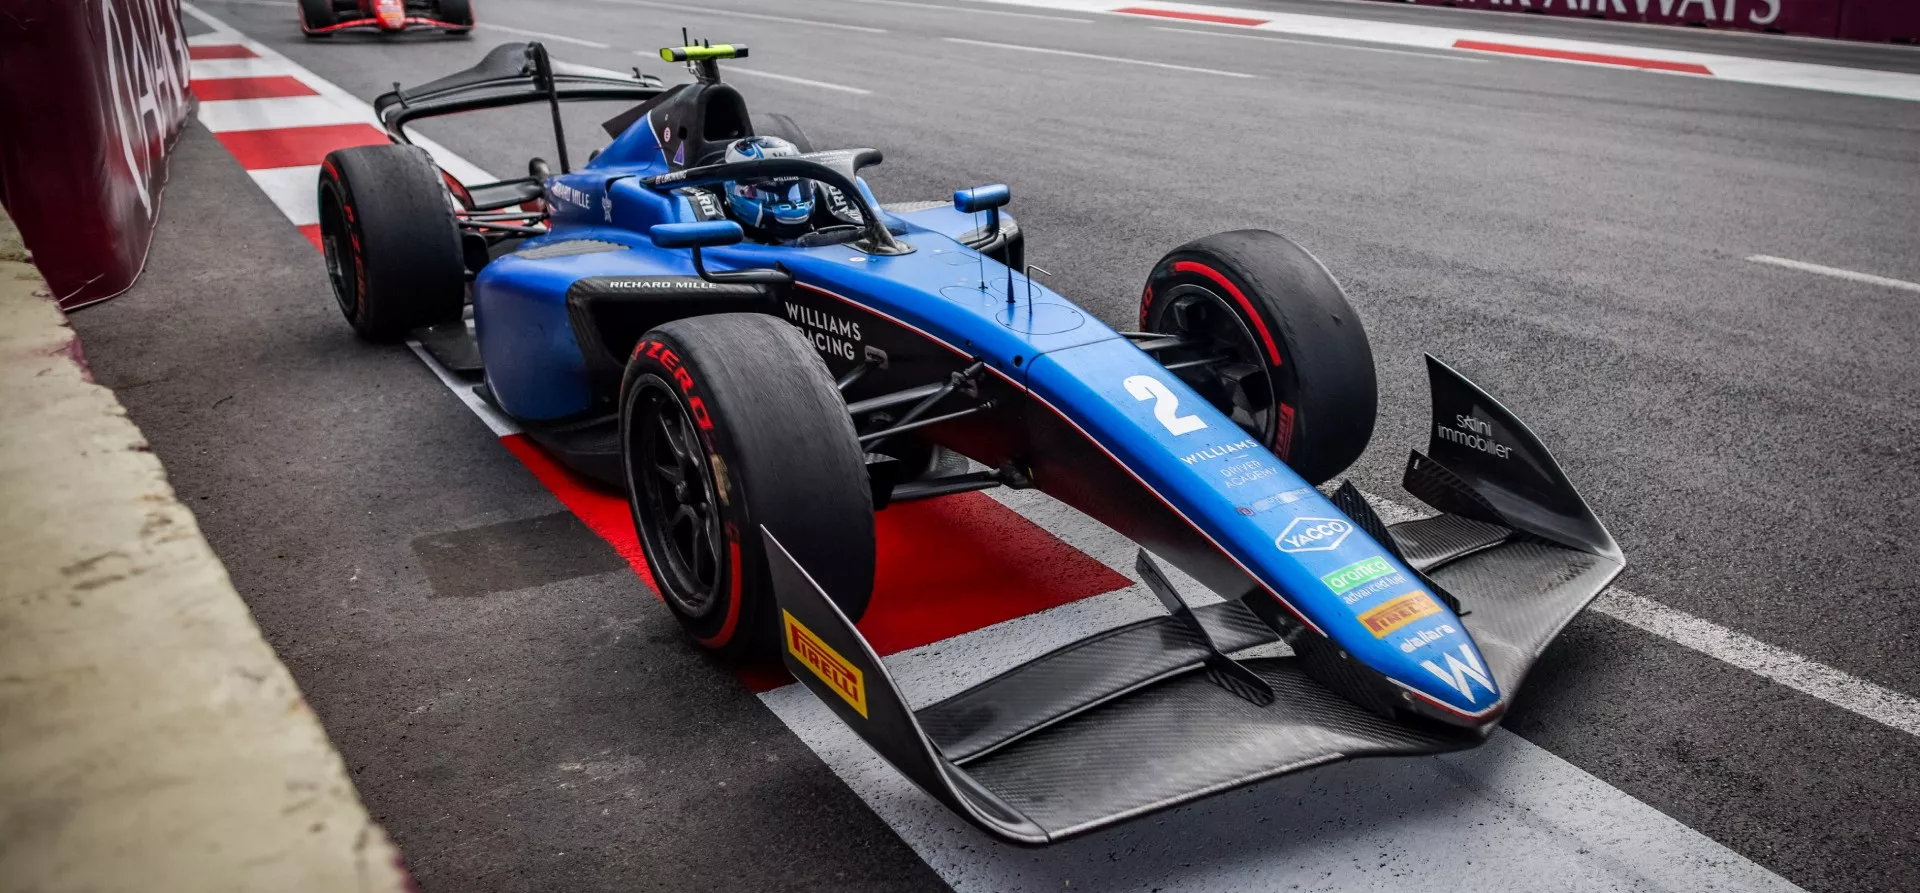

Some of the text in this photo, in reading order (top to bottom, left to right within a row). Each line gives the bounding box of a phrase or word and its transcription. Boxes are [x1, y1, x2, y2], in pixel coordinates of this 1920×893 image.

[609, 281, 671, 289] RICHARD
[784, 301, 862, 341] WILLIAMS
[646, 340, 714, 430] ZERO
[1123, 374, 1208, 437] 2
[1180, 439, 1259, 465] WILLIAMS
[1220, 460, 1263, 478] DRIVER
[1224, 466, 1279, 489] ACADEMY
[1284, 520, 1344, 548] YACCO
[1343, 577, 1389, 605] advanced
[1400, 622, 1457, 654] dallara
[790, 622, 859, 703] PIRELLI
[1420, 643, 1496, 704] W
